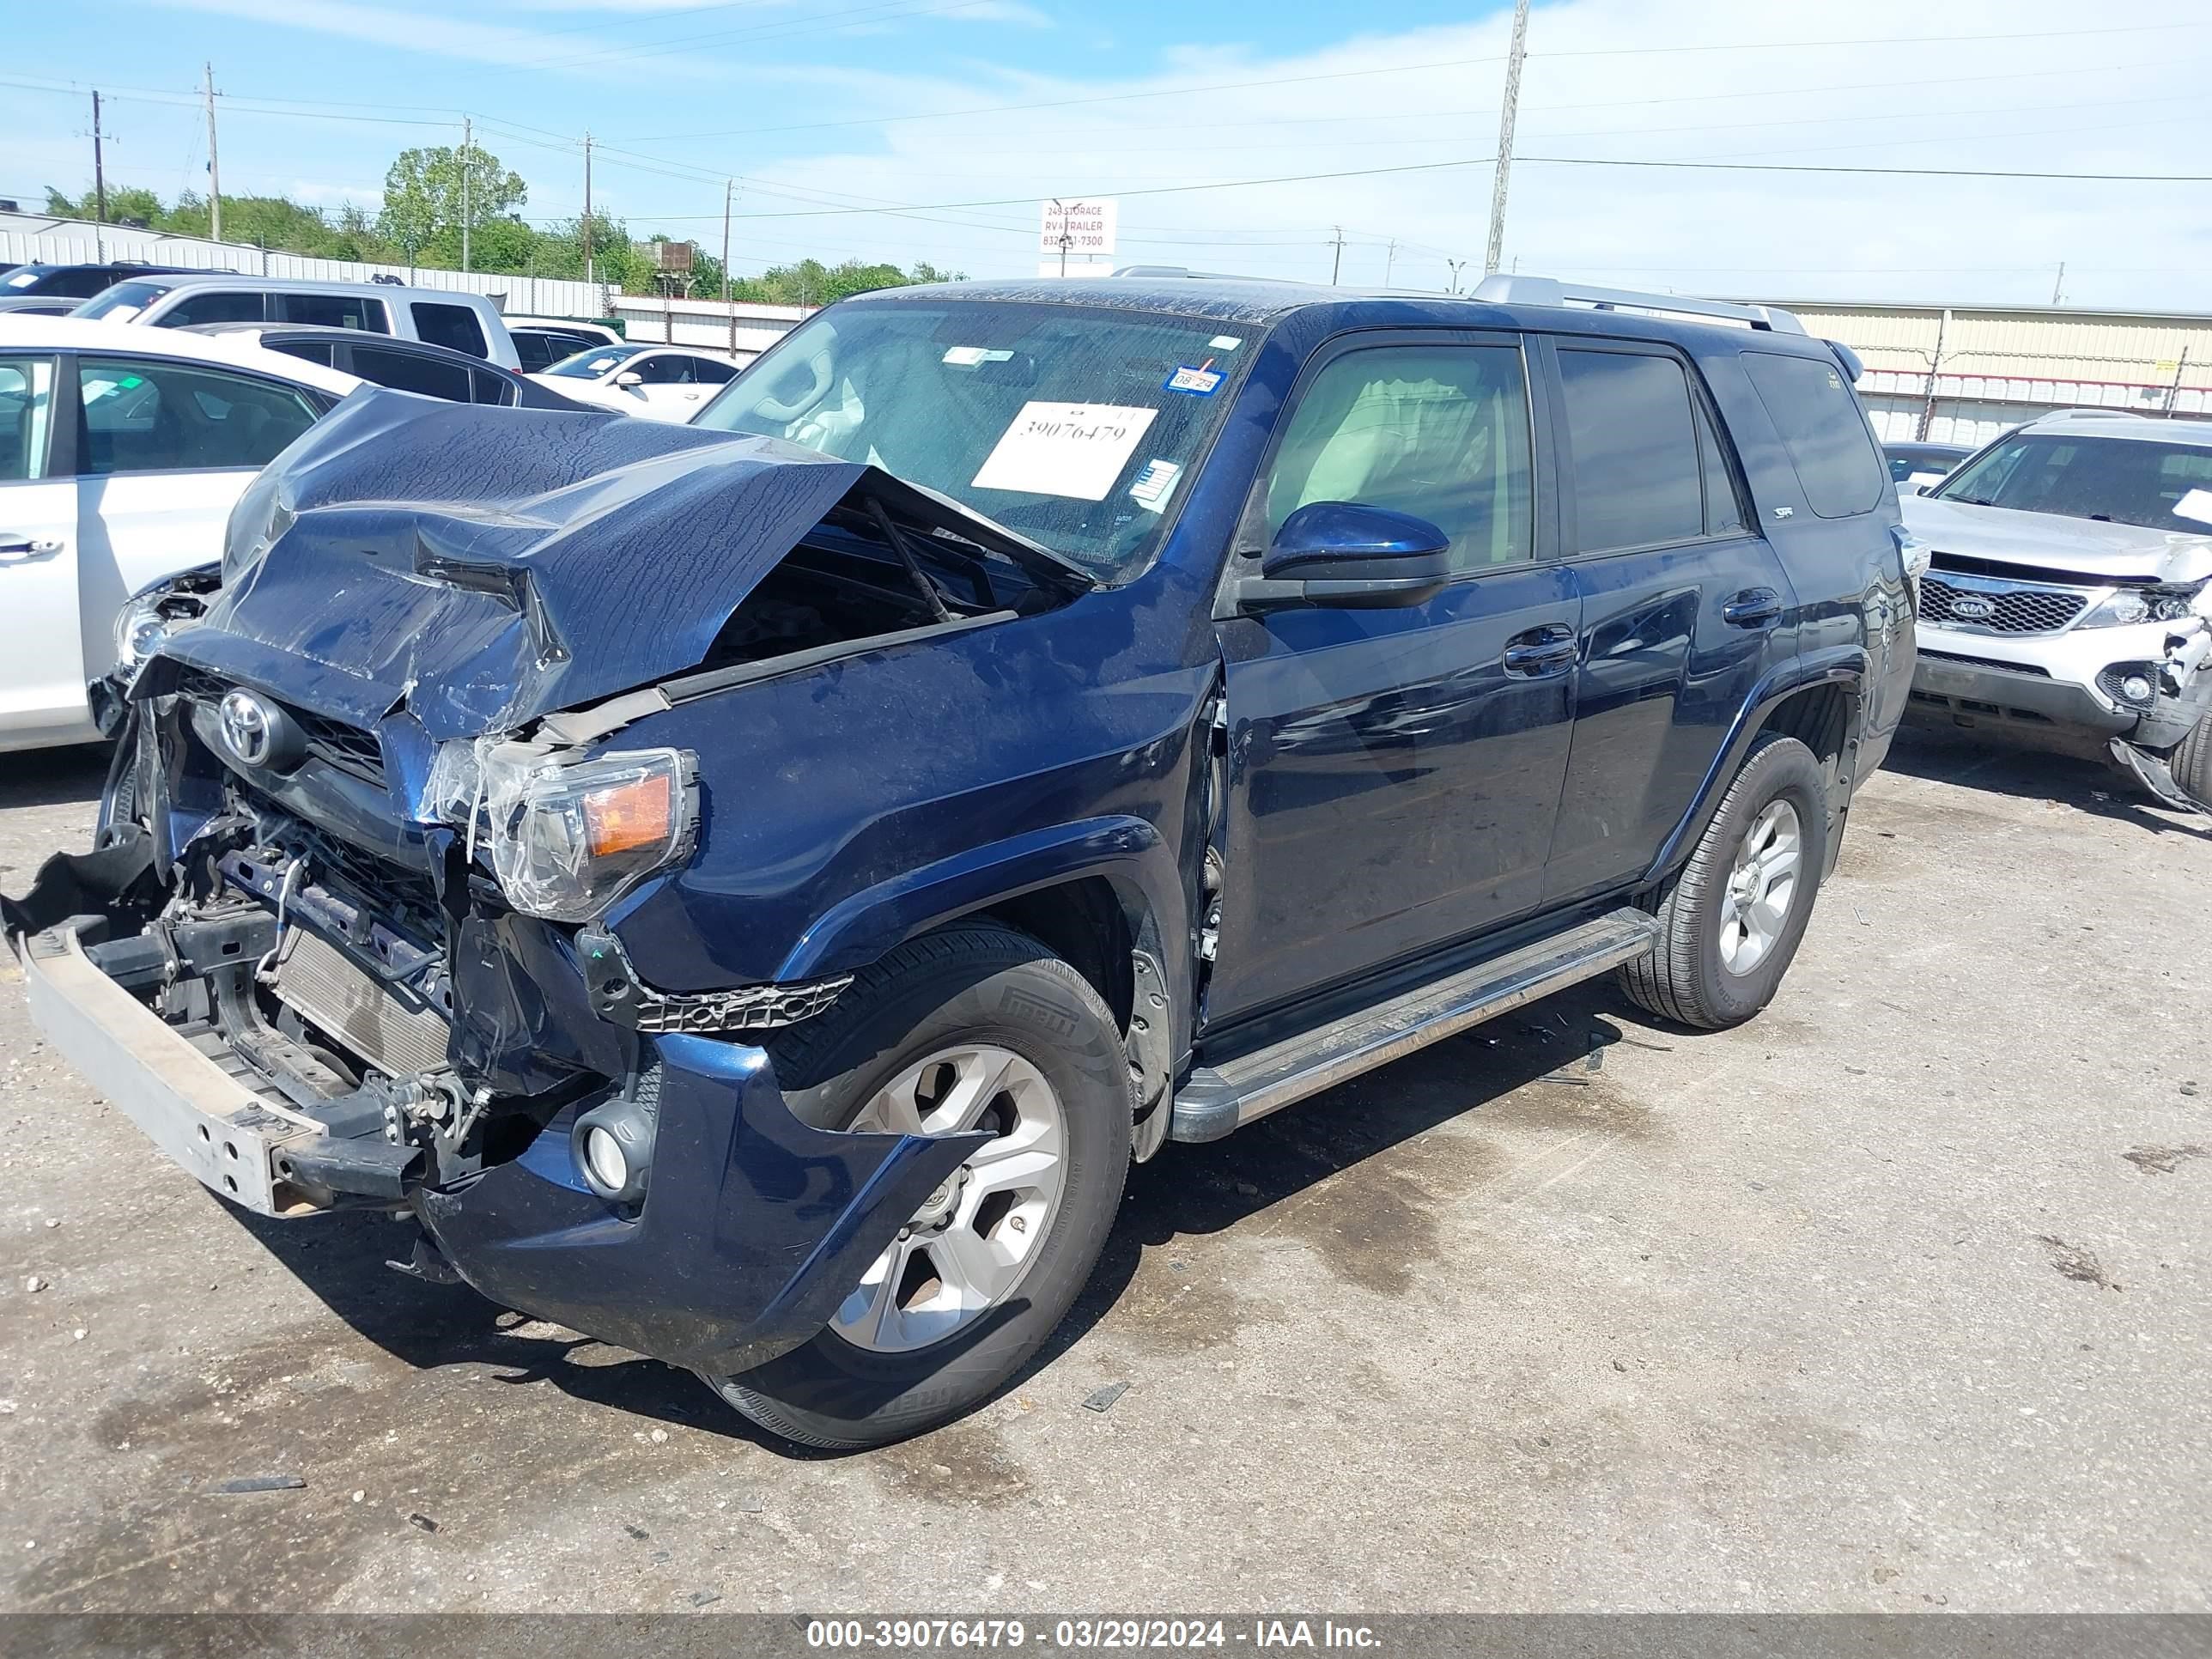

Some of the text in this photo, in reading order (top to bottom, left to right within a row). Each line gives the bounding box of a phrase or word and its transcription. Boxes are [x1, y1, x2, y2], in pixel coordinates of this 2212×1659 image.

[1048, 207, 1103, 216] 249 STORAGE
[1045, 222, 1058, 231] RV
[1043, 235, 1103, 246] 8321-7300
[1175, 375, 1193, 385] 08
[1020, 421, 1127, 441] 39076479
[997, 984, 1079, 1037] PIRELLI
